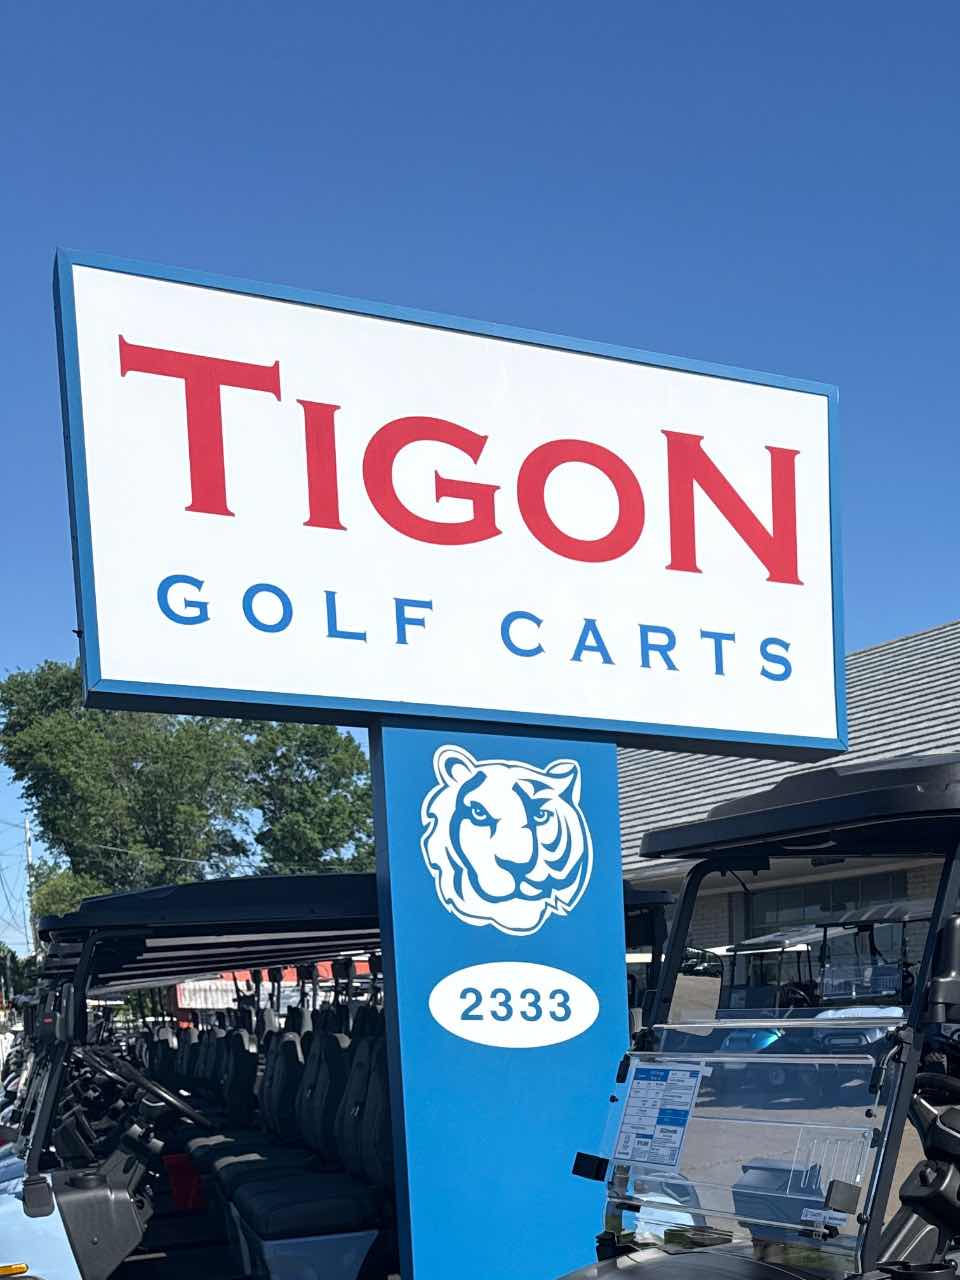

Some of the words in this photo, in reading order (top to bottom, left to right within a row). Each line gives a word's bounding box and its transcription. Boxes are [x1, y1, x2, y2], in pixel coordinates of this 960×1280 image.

[118, 334, 803, 586] TIGON
[156, 574, 434, 646] GOLF
[500, 610, 793, 682] CARTS
[460, 987, 572, 1022] 2333
